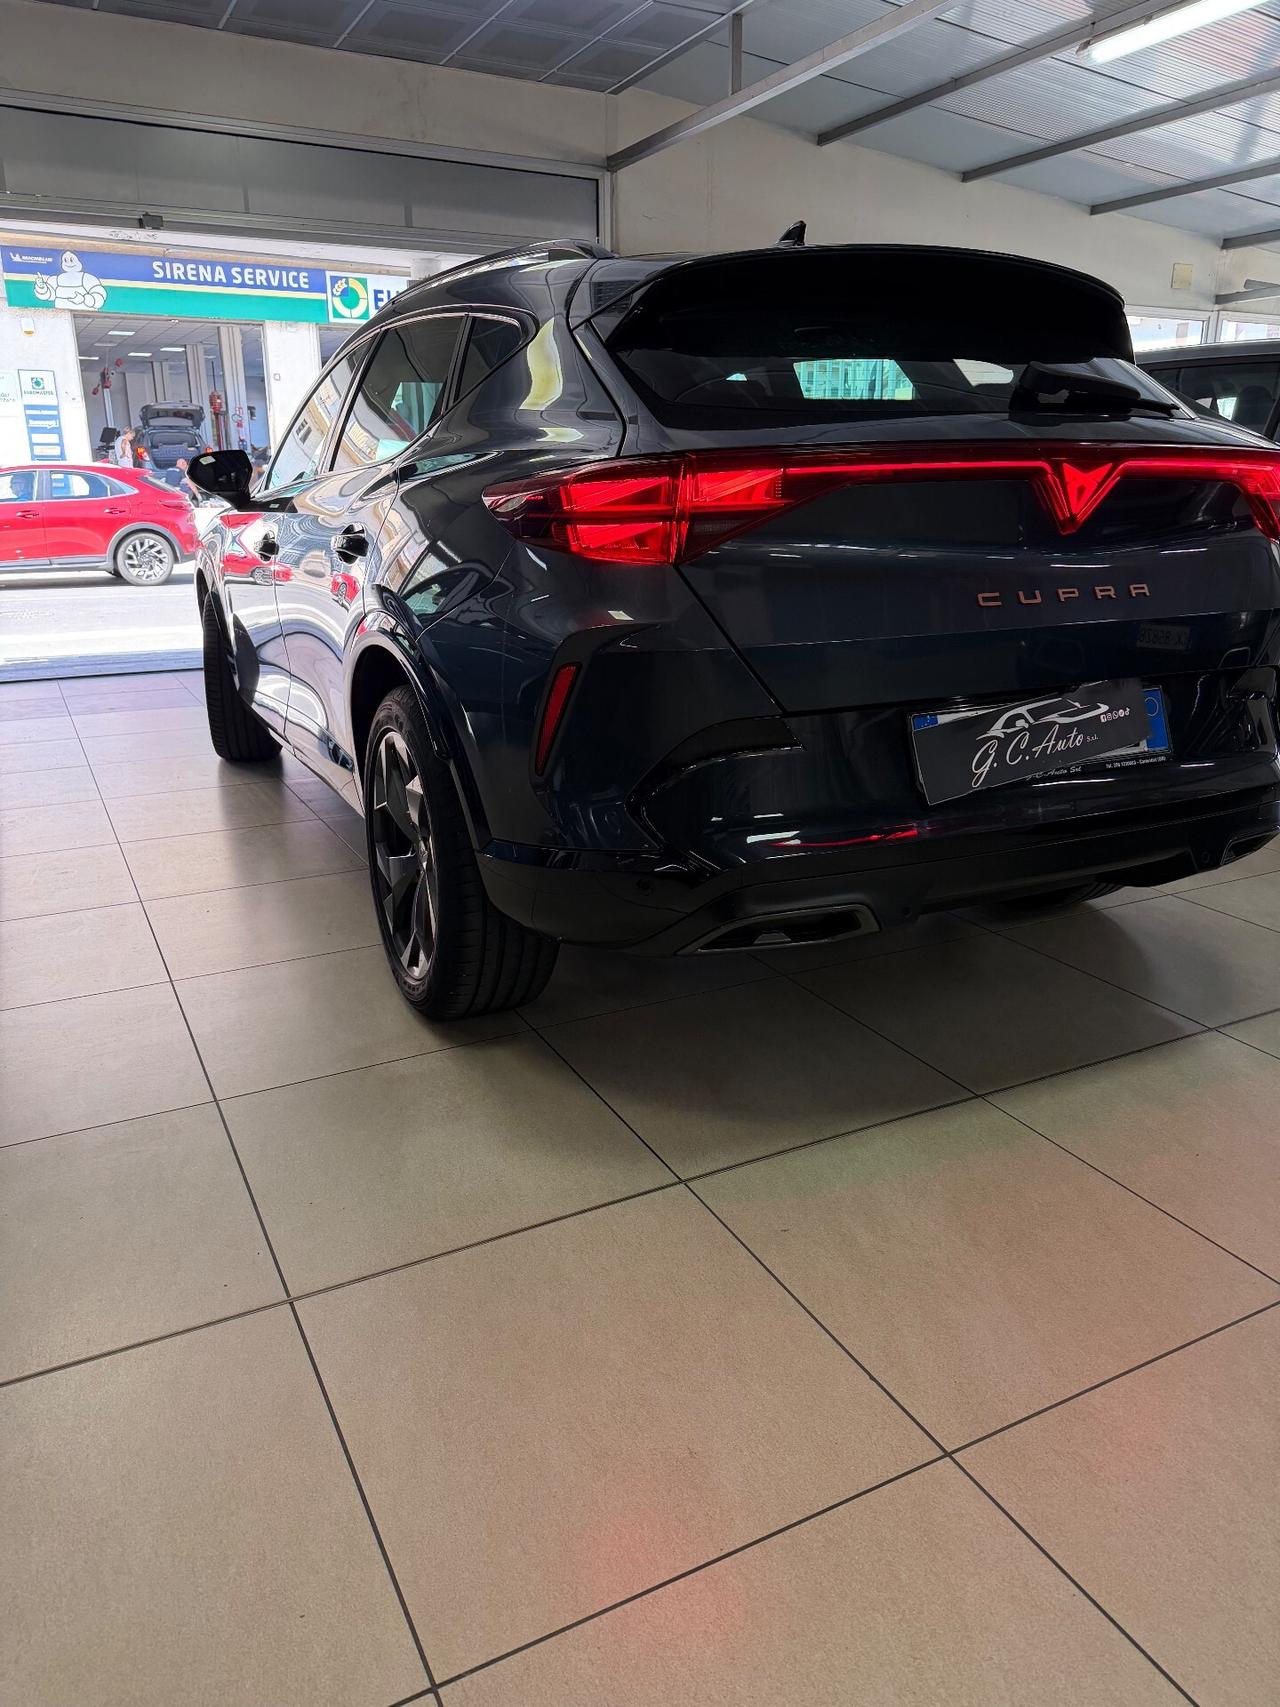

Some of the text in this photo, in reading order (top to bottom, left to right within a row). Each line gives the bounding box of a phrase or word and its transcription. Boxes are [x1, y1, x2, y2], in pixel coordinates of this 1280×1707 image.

[152, 261, 310, 289] SIRENA SERVICE
[977, 583, 1151, 607] CUPRA
